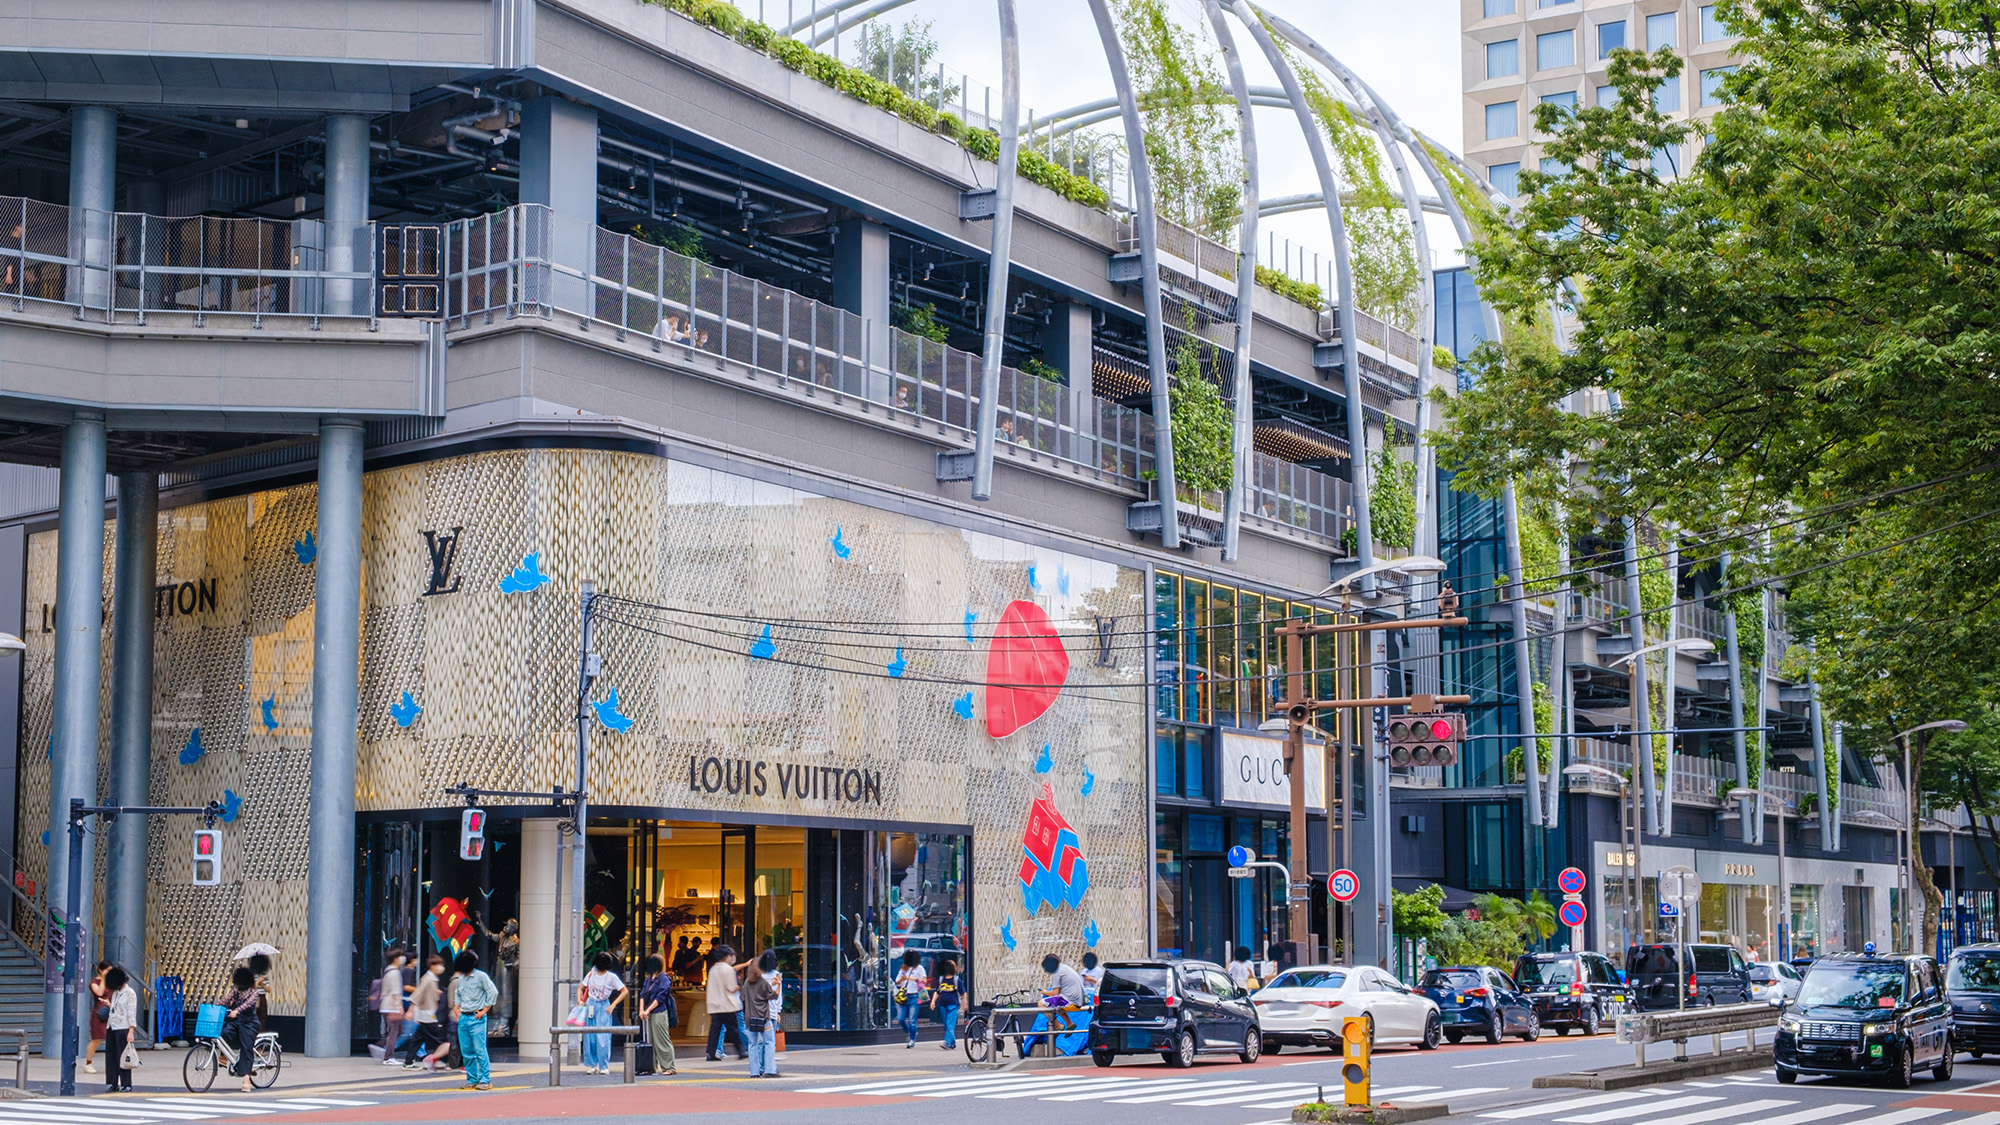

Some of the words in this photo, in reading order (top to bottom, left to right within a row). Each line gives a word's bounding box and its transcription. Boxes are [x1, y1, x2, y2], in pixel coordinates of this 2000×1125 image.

[155, 578, 217, 618] TTON
[1240, 755, 1289, 786] GUC
[690, 755, 767, 797] LOUIS
[776, 763, 881, 806] VUITTON
[1606, 852, 1636, 866] BALENAGA
[1725, 863, 1755, 877] PRADA
[1334, 878, 1353, 893] 50
[1601, 1001, 1626, 1020] S.RIDE
